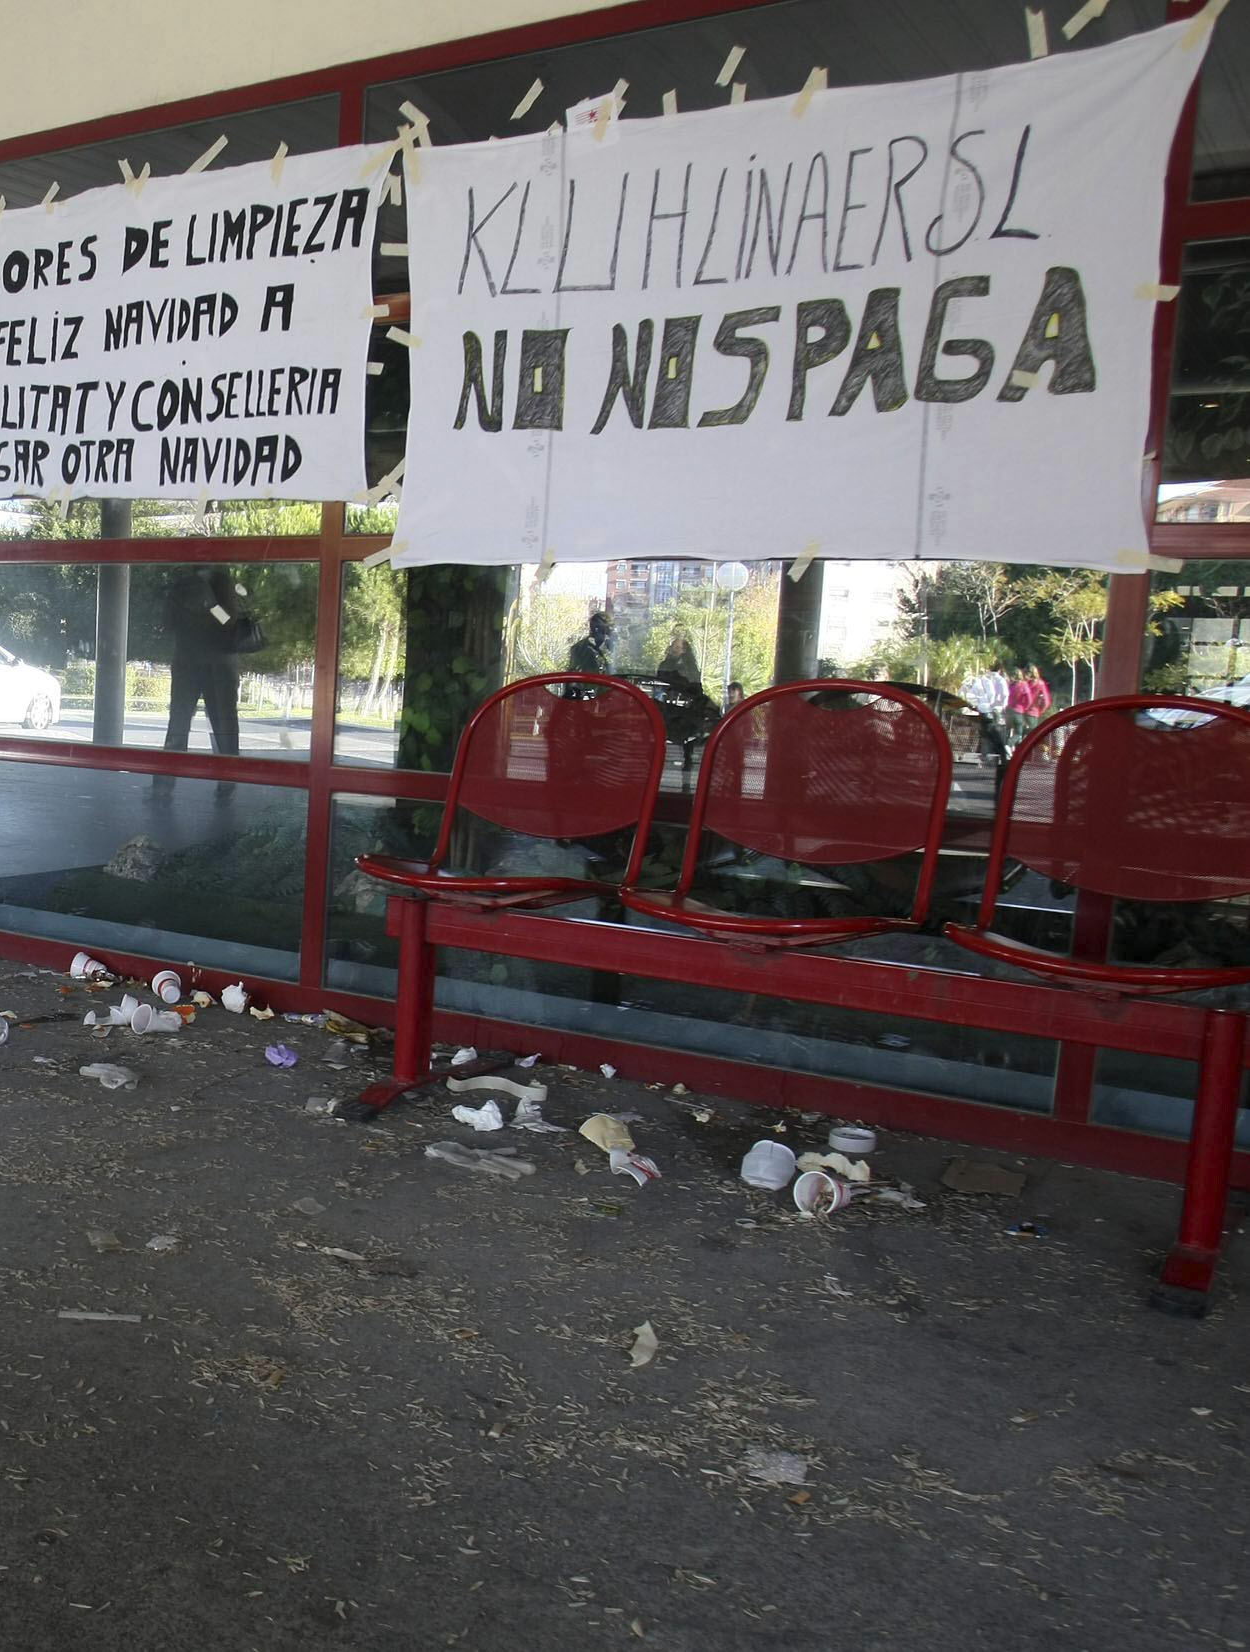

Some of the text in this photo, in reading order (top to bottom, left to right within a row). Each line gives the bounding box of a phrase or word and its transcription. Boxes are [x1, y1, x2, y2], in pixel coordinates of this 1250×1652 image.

[122, 219, 173, 276] DE
[185, 187, 371, 267] LIMPIEZA
[457, 162, 692, 296] KLUH
[103, 291, 240, 352] NAVIDAD
[260, 283, 295, 332] A
[452, 265, 1097, 436] NO NOS PAGA
[105, 380, 127, 432] Y
[131, 366, 342, 432] CONSELLERIA
[61, 438, 135, 485] OTRA
[159, 434, 303, 486] NAVIDAD
